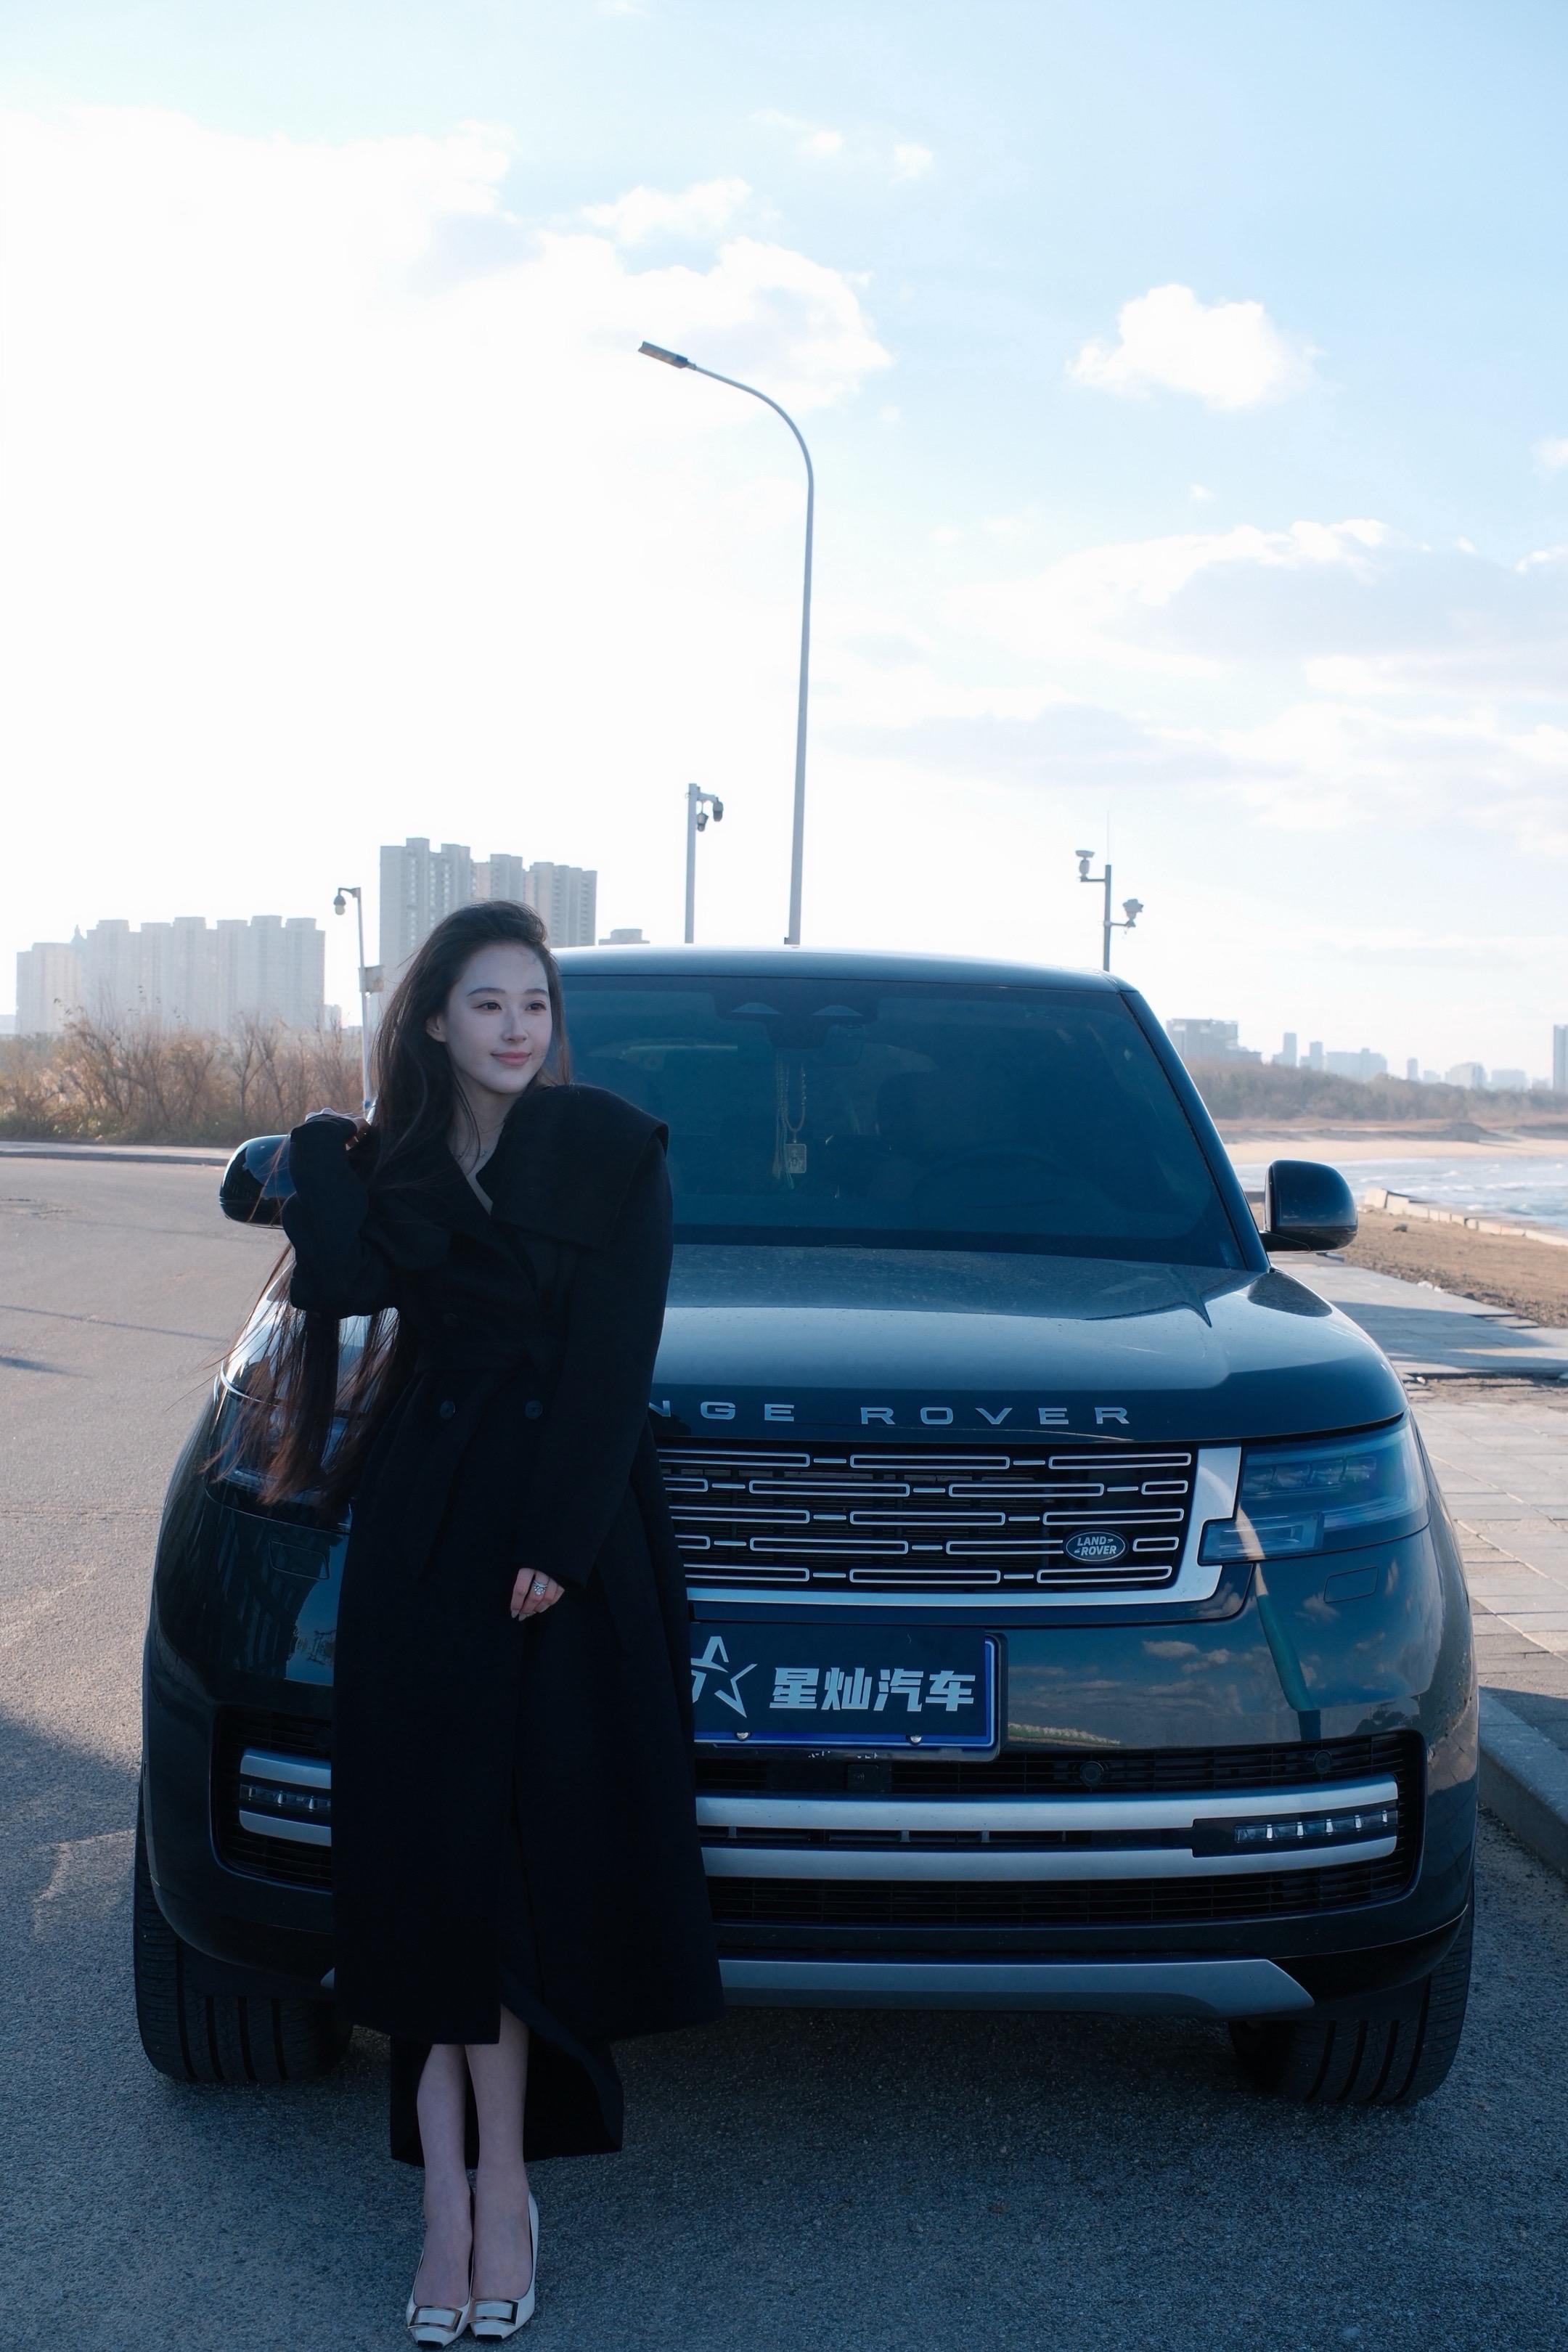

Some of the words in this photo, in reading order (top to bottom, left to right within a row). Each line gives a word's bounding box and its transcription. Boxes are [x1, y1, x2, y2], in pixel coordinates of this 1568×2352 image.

[861, 1407, 1130, 1425] ROVER
[1077, 1536, 1107, 1546] LAND
[1081, 1545, 1117, 1556] ROVER
[769, 1667, 976, 1712] 星灿汽车
